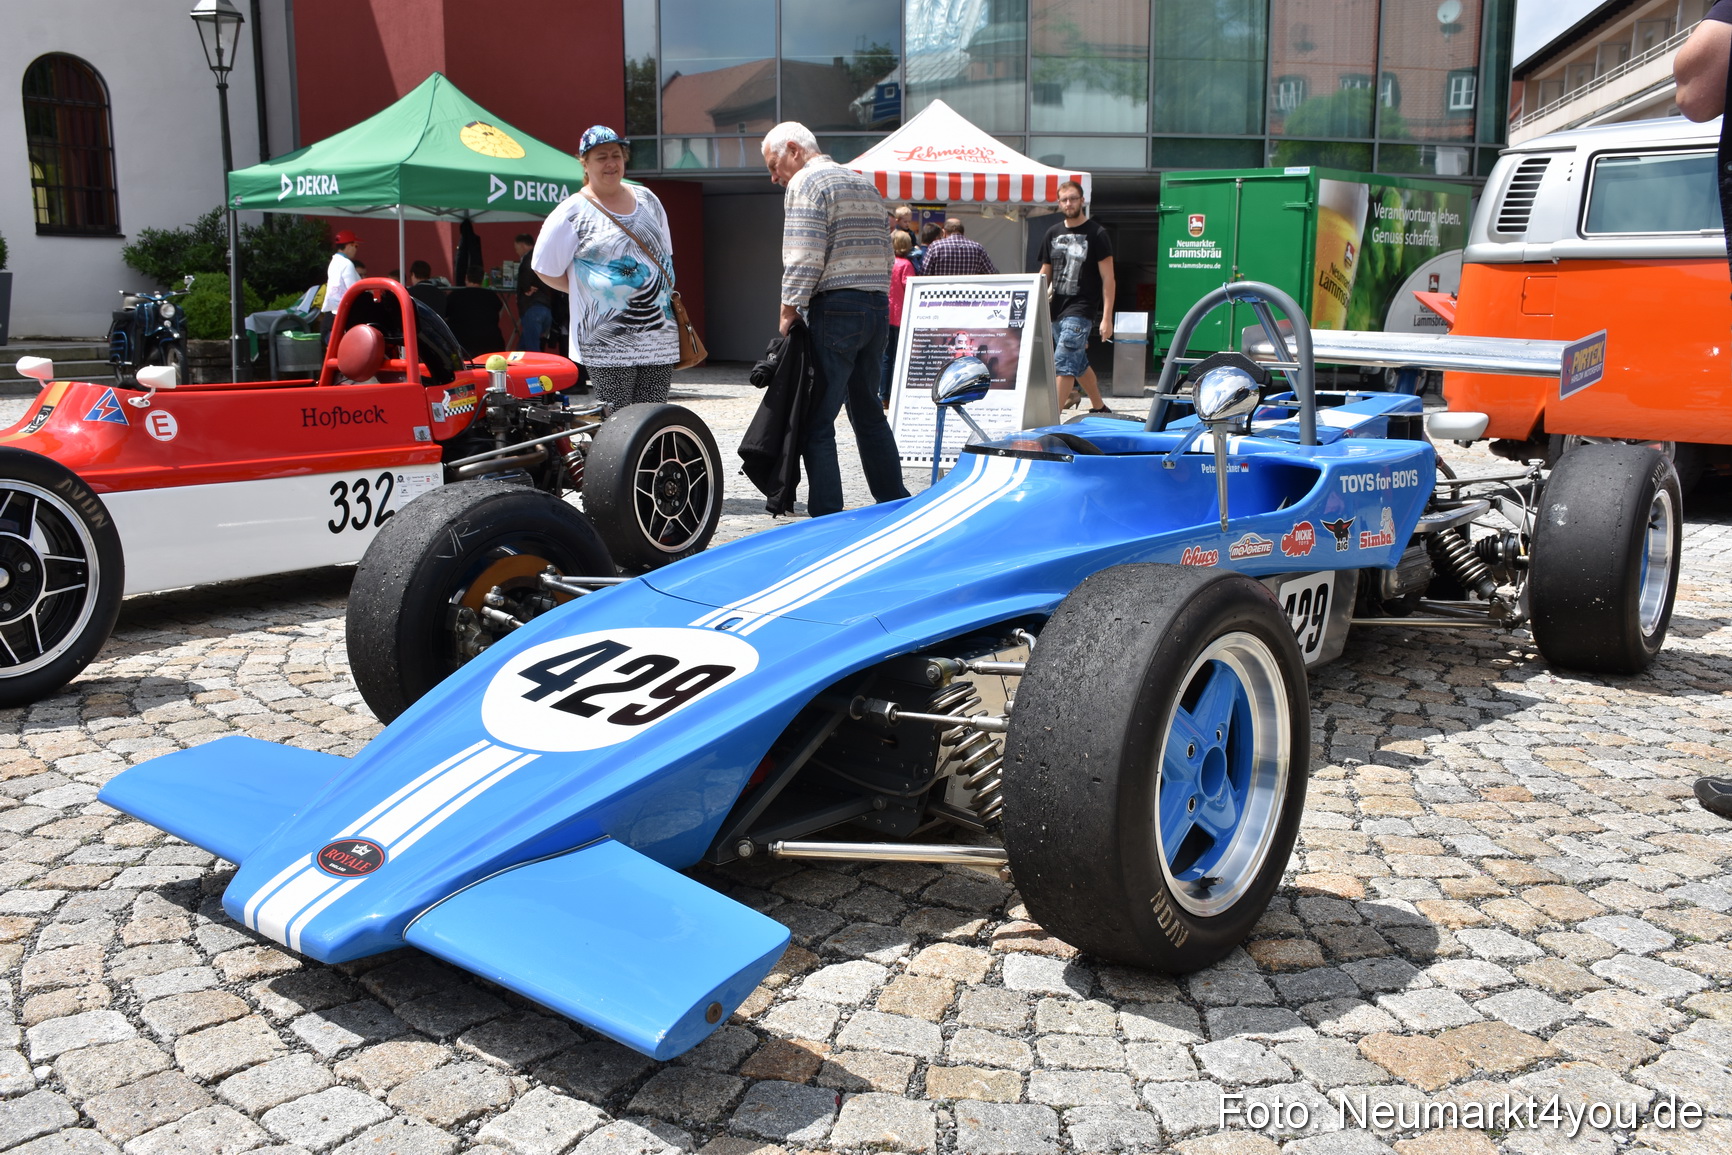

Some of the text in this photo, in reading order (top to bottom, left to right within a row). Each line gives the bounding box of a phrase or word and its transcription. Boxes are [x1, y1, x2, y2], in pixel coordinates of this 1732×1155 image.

[893, 145, 995, 162] Lehmeier's
[296, 174, 340, 196] DEKRA
[514, 182, 570, 202] DEKRA
[1374, 202, 1461, 226] Verantwortung leben.
[1176, 239, 1216, 248] Neumarkter
[1372, 226, 1441, 246] Genuss schaffen.
[1168, 248, 1222, 258] Lammsbräu
[152, 414, 172, 436] E
[301, 405, 388, 430] Hofbeck
[1201, 464, 1216, 474] Pete
[1340, 470, 1418, 494] TOYS for BOYS
[328, 472, 396, 534] 332
[1295, 529, 1313, 542] DICKIE
[1360, 530, 1392, 548] Simba
[1337, 542, 1348, 551] BIG
[517, 639, 736, 726] 429
[324, 848, 372, 872] ROYALE
[1150, 886, 1189, 948] AVON
